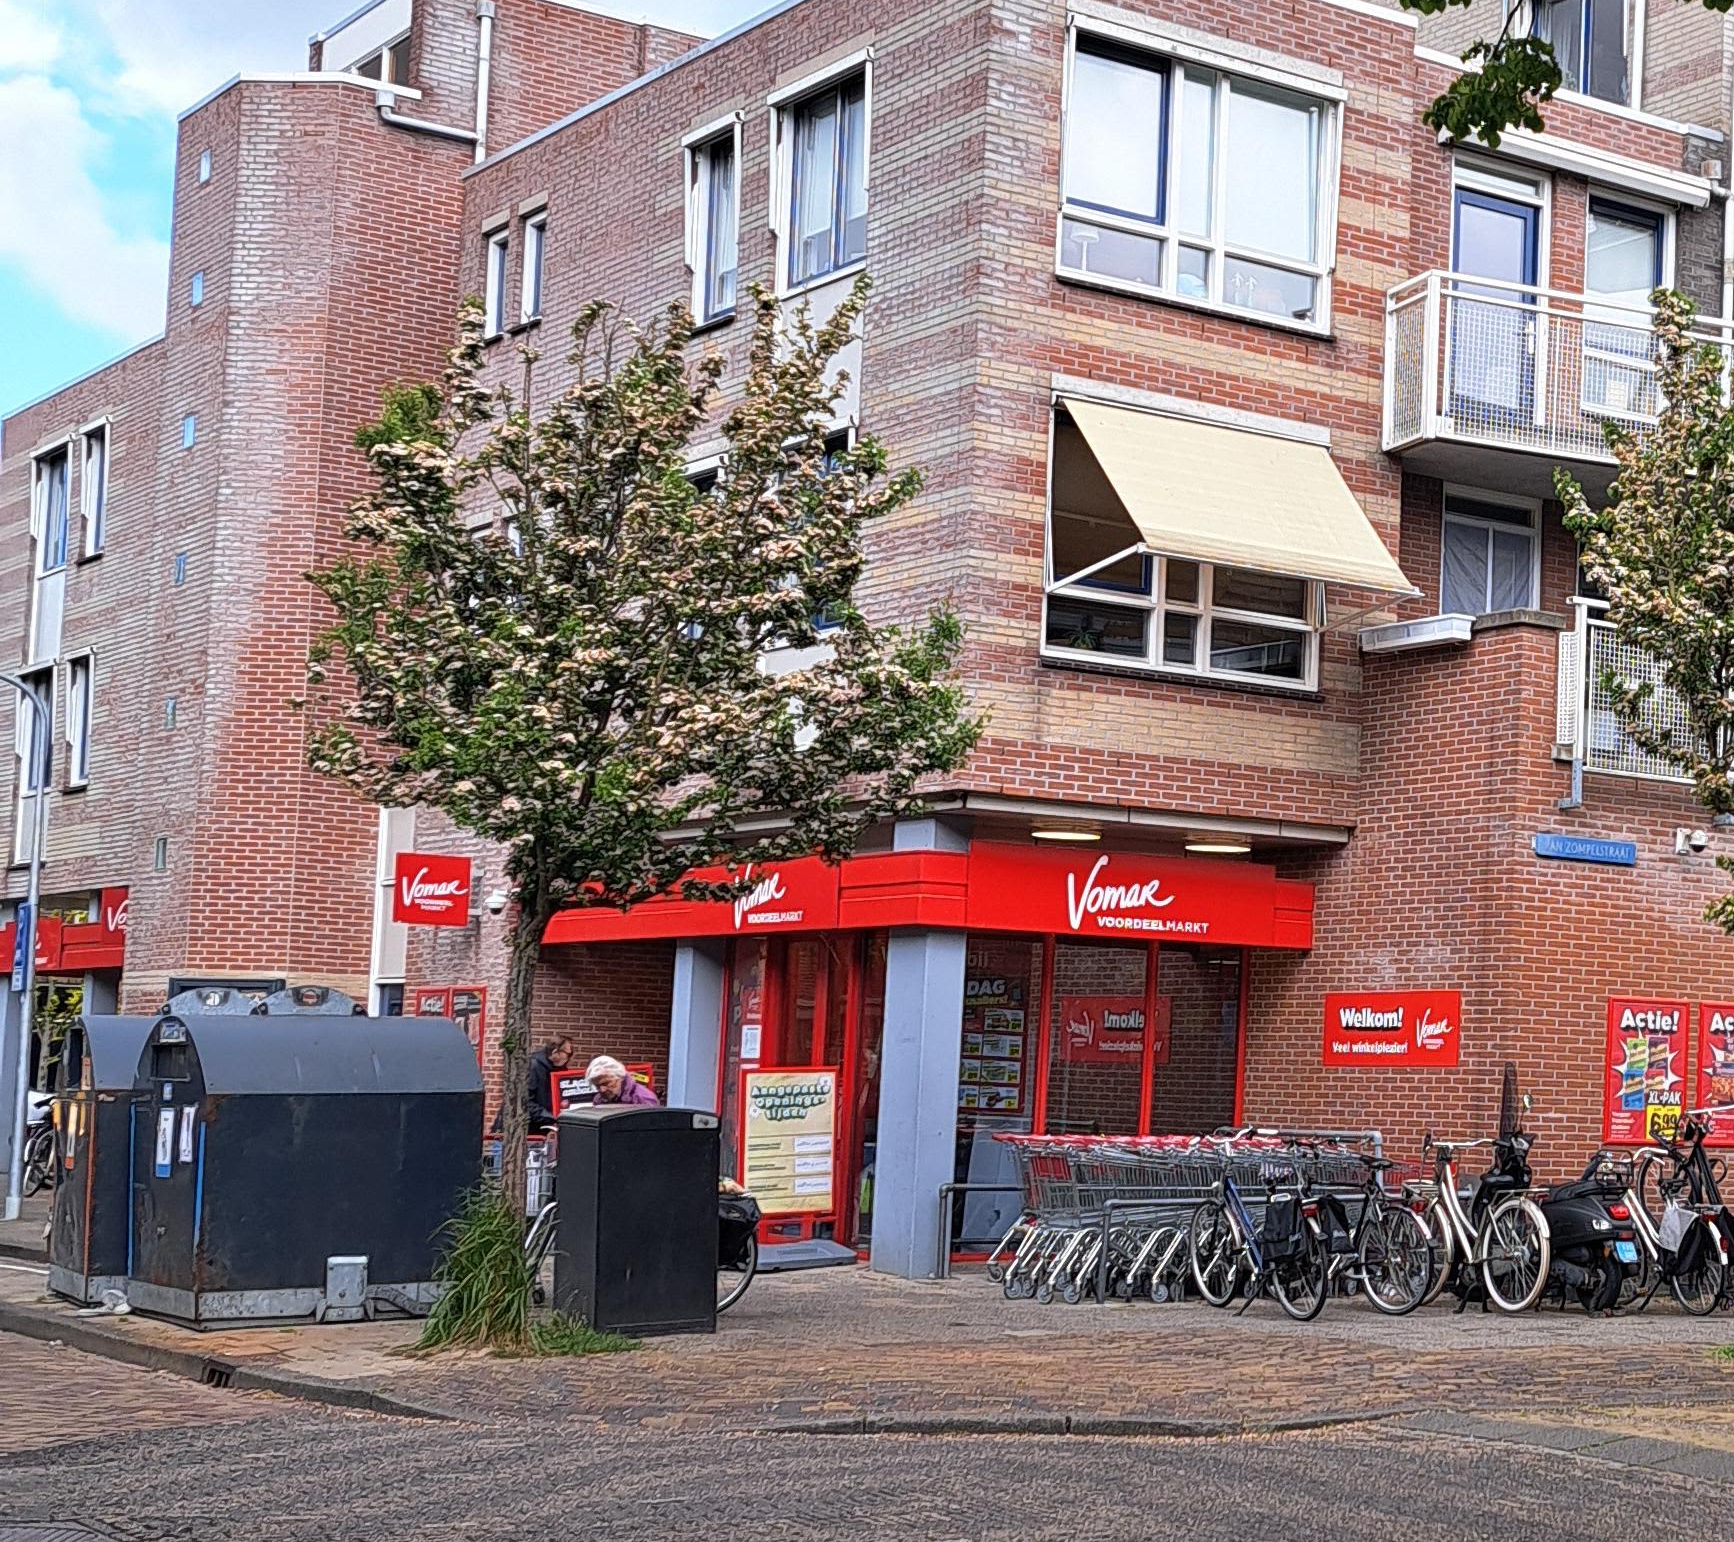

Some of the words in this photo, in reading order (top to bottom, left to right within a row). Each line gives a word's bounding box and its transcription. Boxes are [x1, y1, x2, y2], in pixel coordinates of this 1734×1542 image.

[1067, 854, 1176, 930] Vomar
[1339, 1006, 1404, 1028] Welkom!
[1620, 1008, 1680, 1032] Actie!
